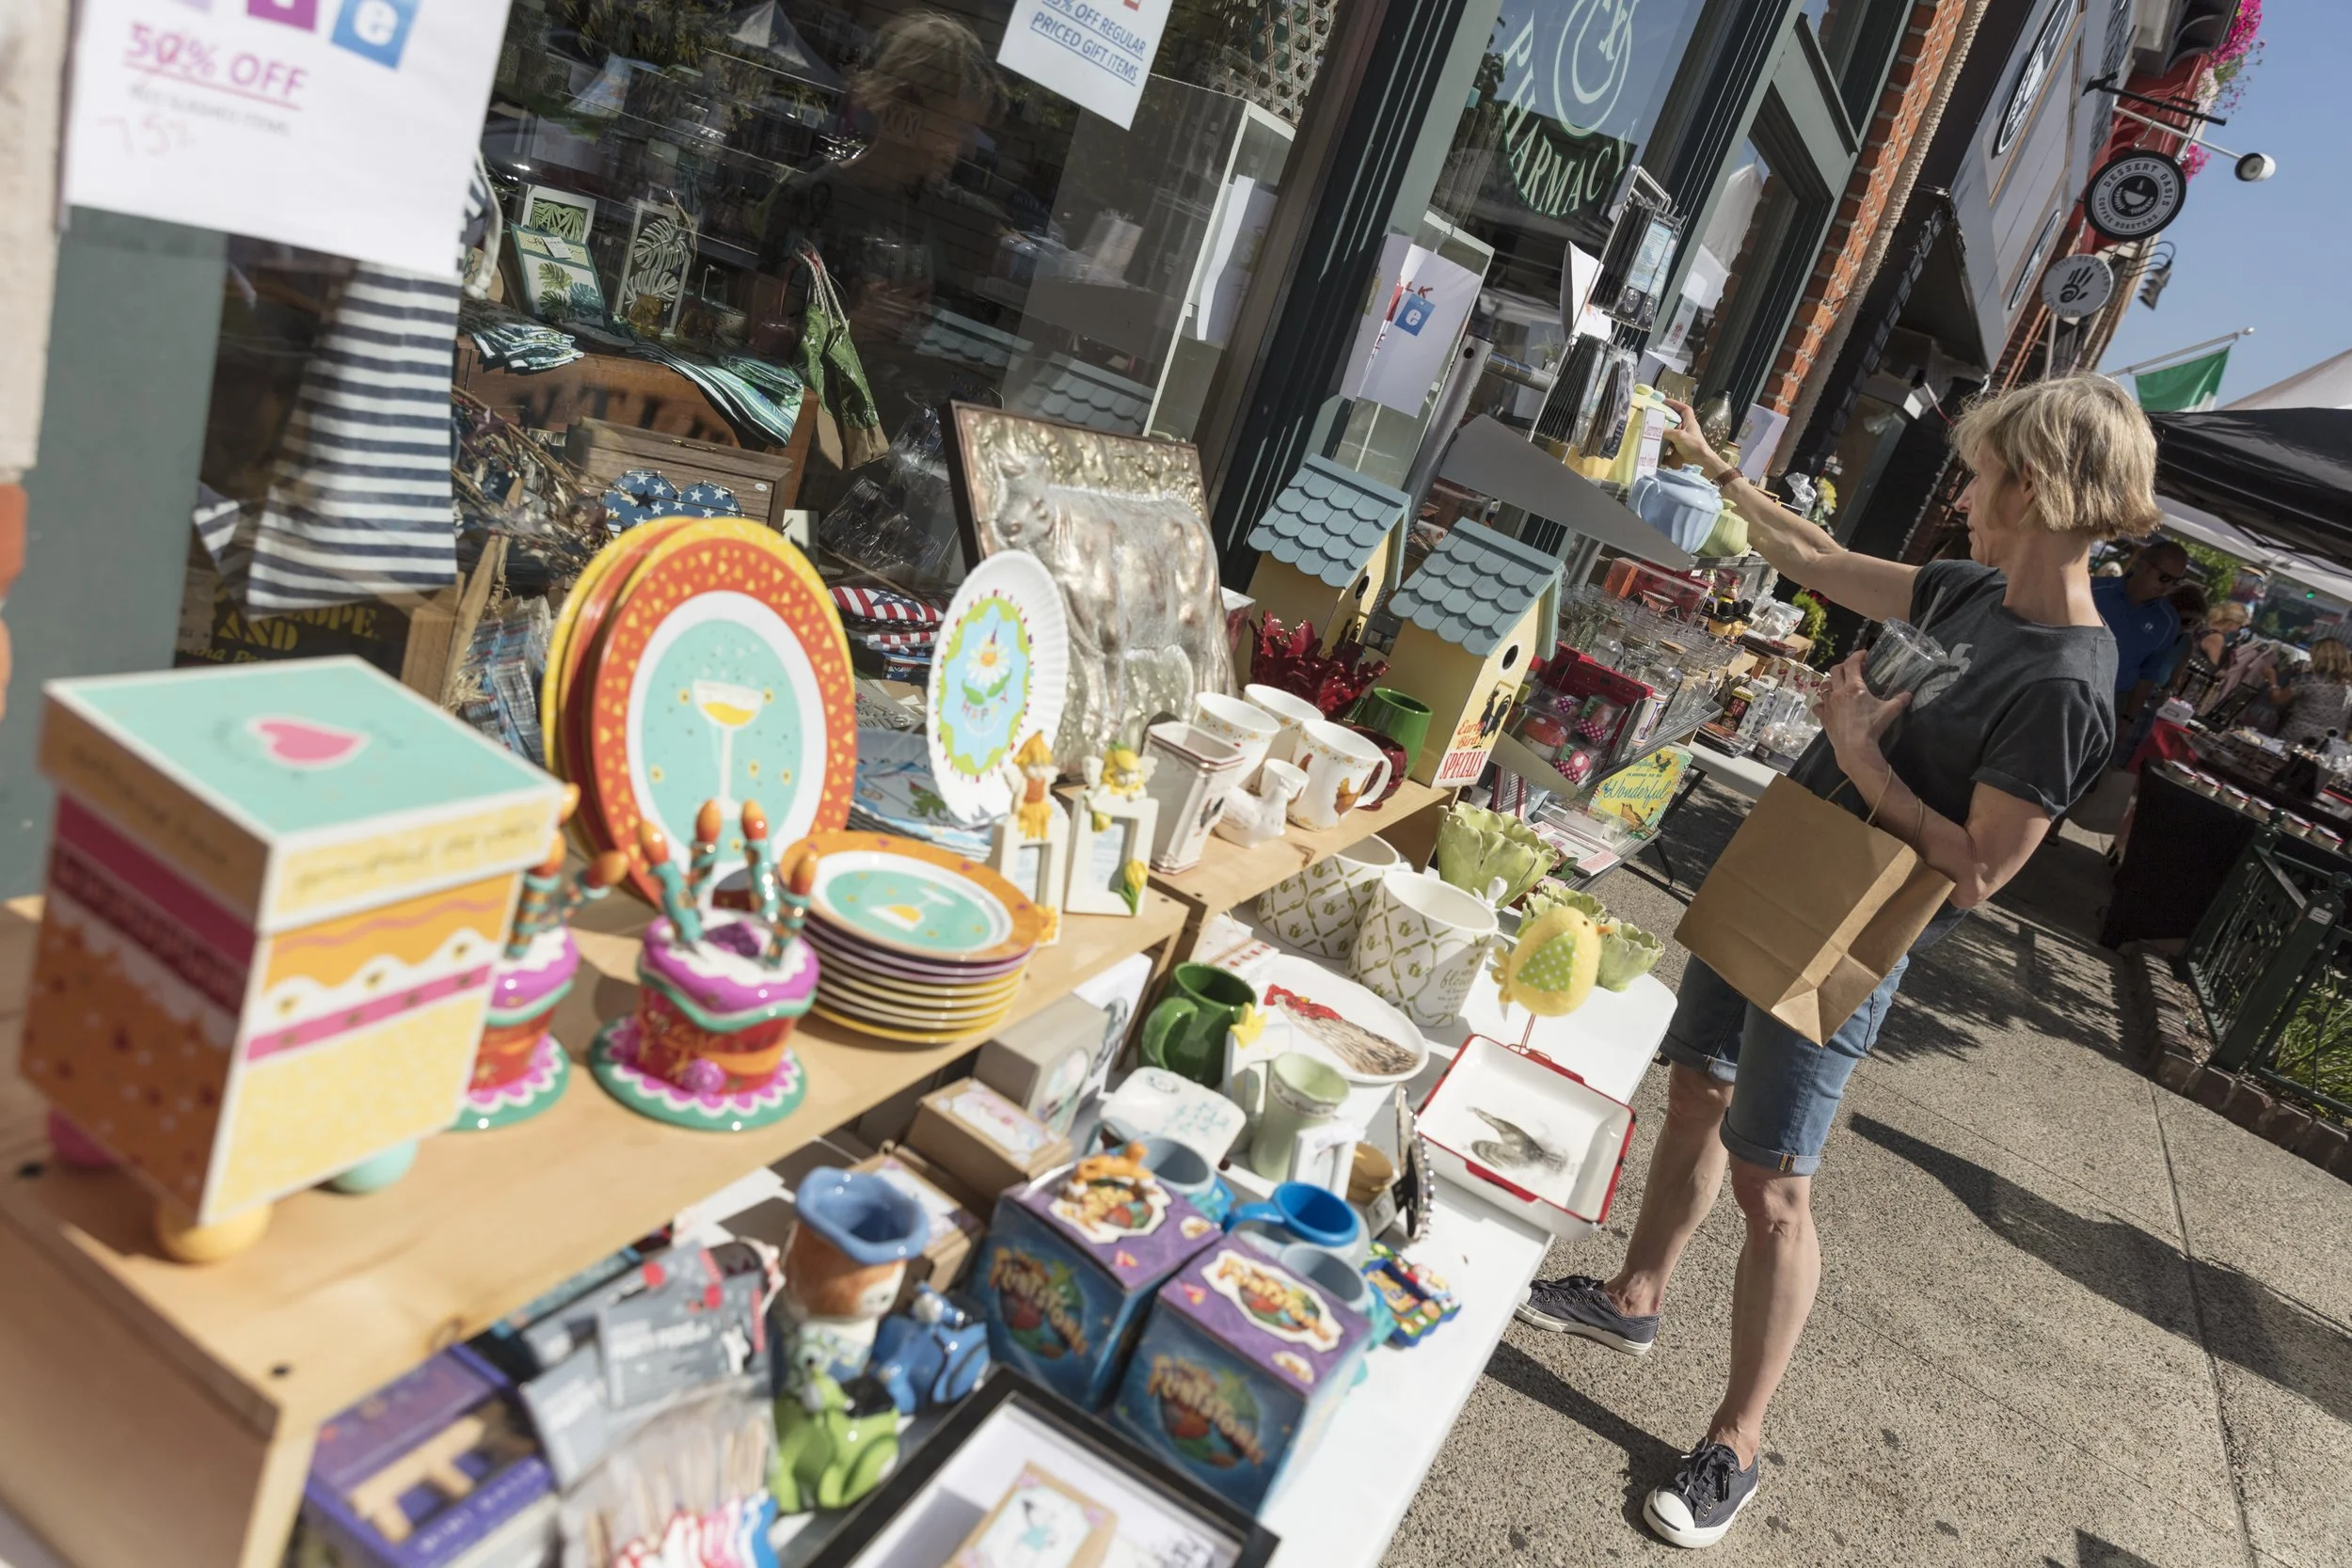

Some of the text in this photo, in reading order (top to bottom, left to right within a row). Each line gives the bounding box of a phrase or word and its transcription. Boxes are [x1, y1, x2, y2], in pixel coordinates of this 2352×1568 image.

[1031, 11, 1139, 83] PRICED GIFT ITEMS
[1074, 4, 1100, 26] OFF
[1099, 17, 1147, 56] REGULAR
[229, 51, 310, 98] OFF
[1502, 8, 1638, 217] PHARMACY
[2104, 163, 2172, 206] DESSERT OASIS
[217, 611, 299, 651] AND
[1438, 751, 1487, 780] SPECIALS
[1603, 778, 1672, 810] Wonderful
